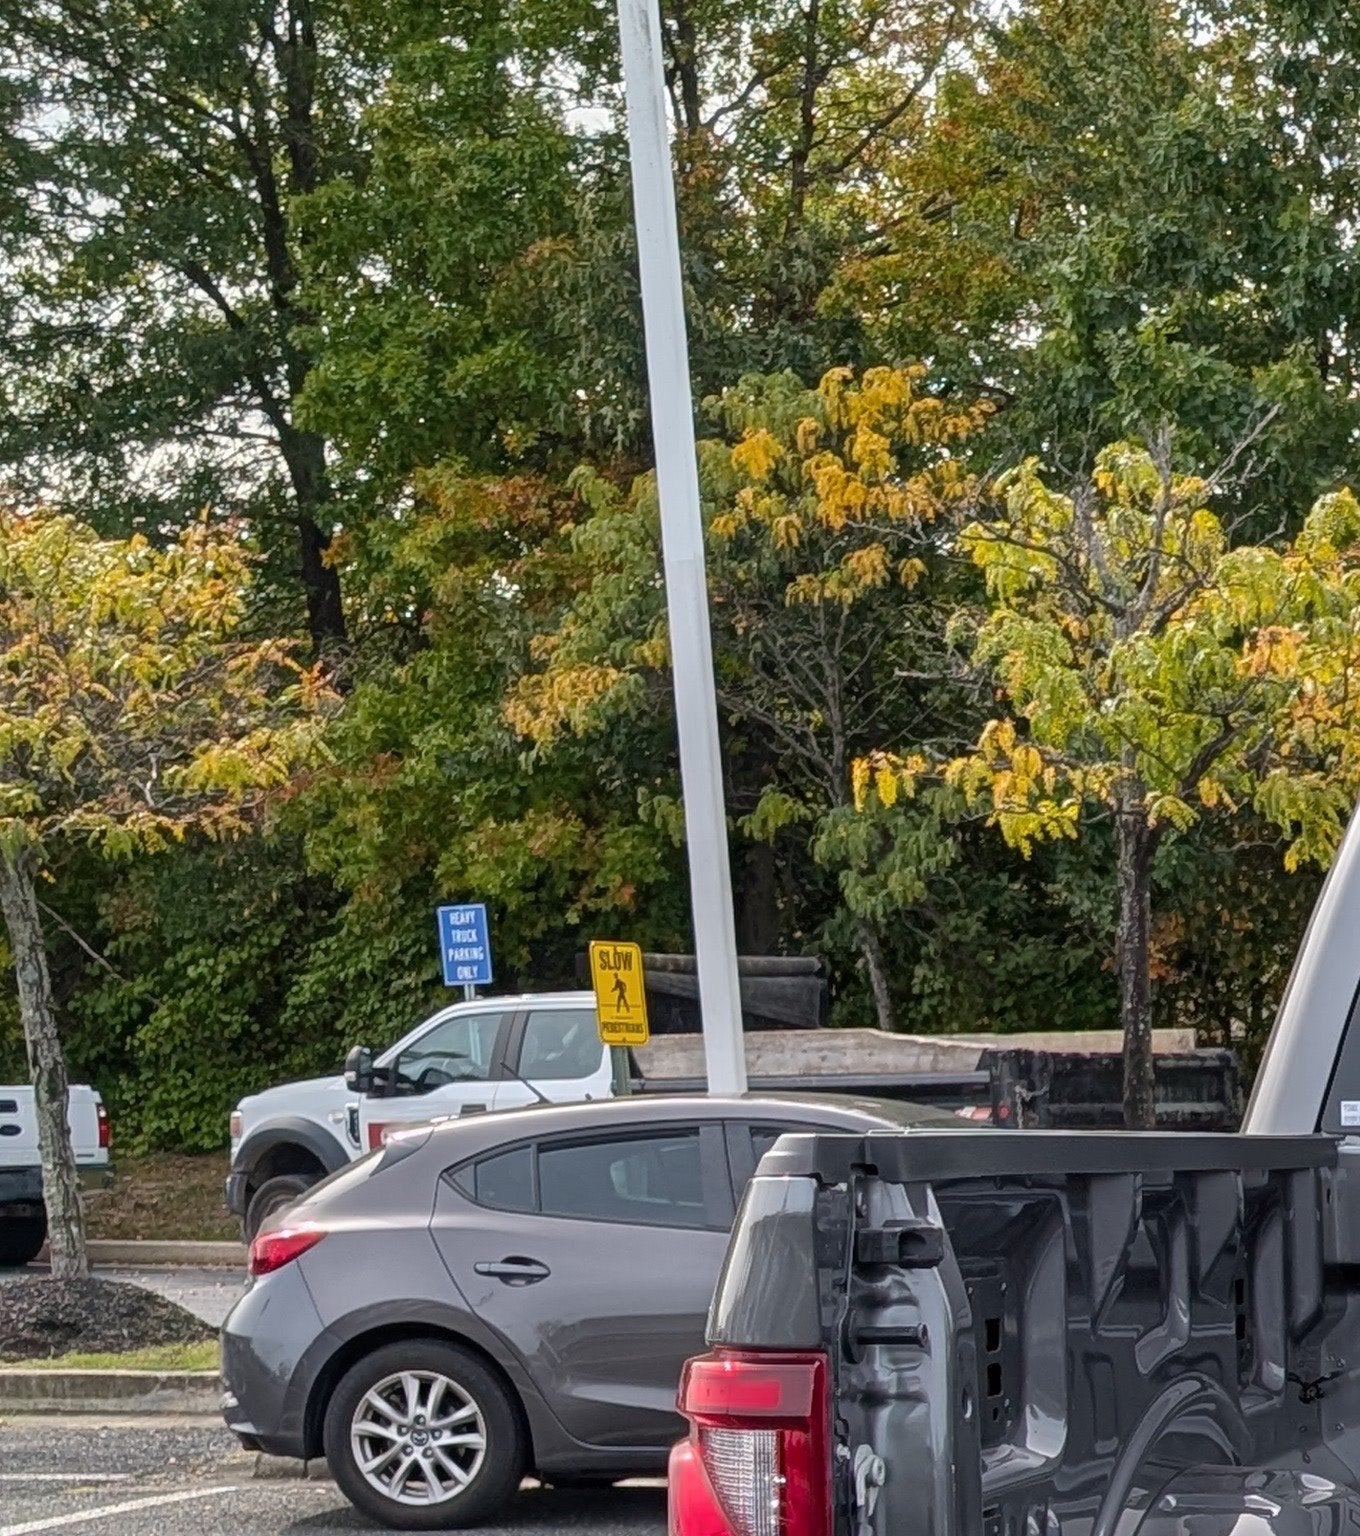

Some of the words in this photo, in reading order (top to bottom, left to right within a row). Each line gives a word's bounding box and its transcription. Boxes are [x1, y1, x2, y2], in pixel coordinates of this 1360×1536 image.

[449, 911, 476, 925] HEAVY
[451, 928, 478, 943] TRUCK
[448, 946, 484, 962] PARKING
[599, 950, 633, 971] SLOW
[456, 965, 478, 980] ONLY
